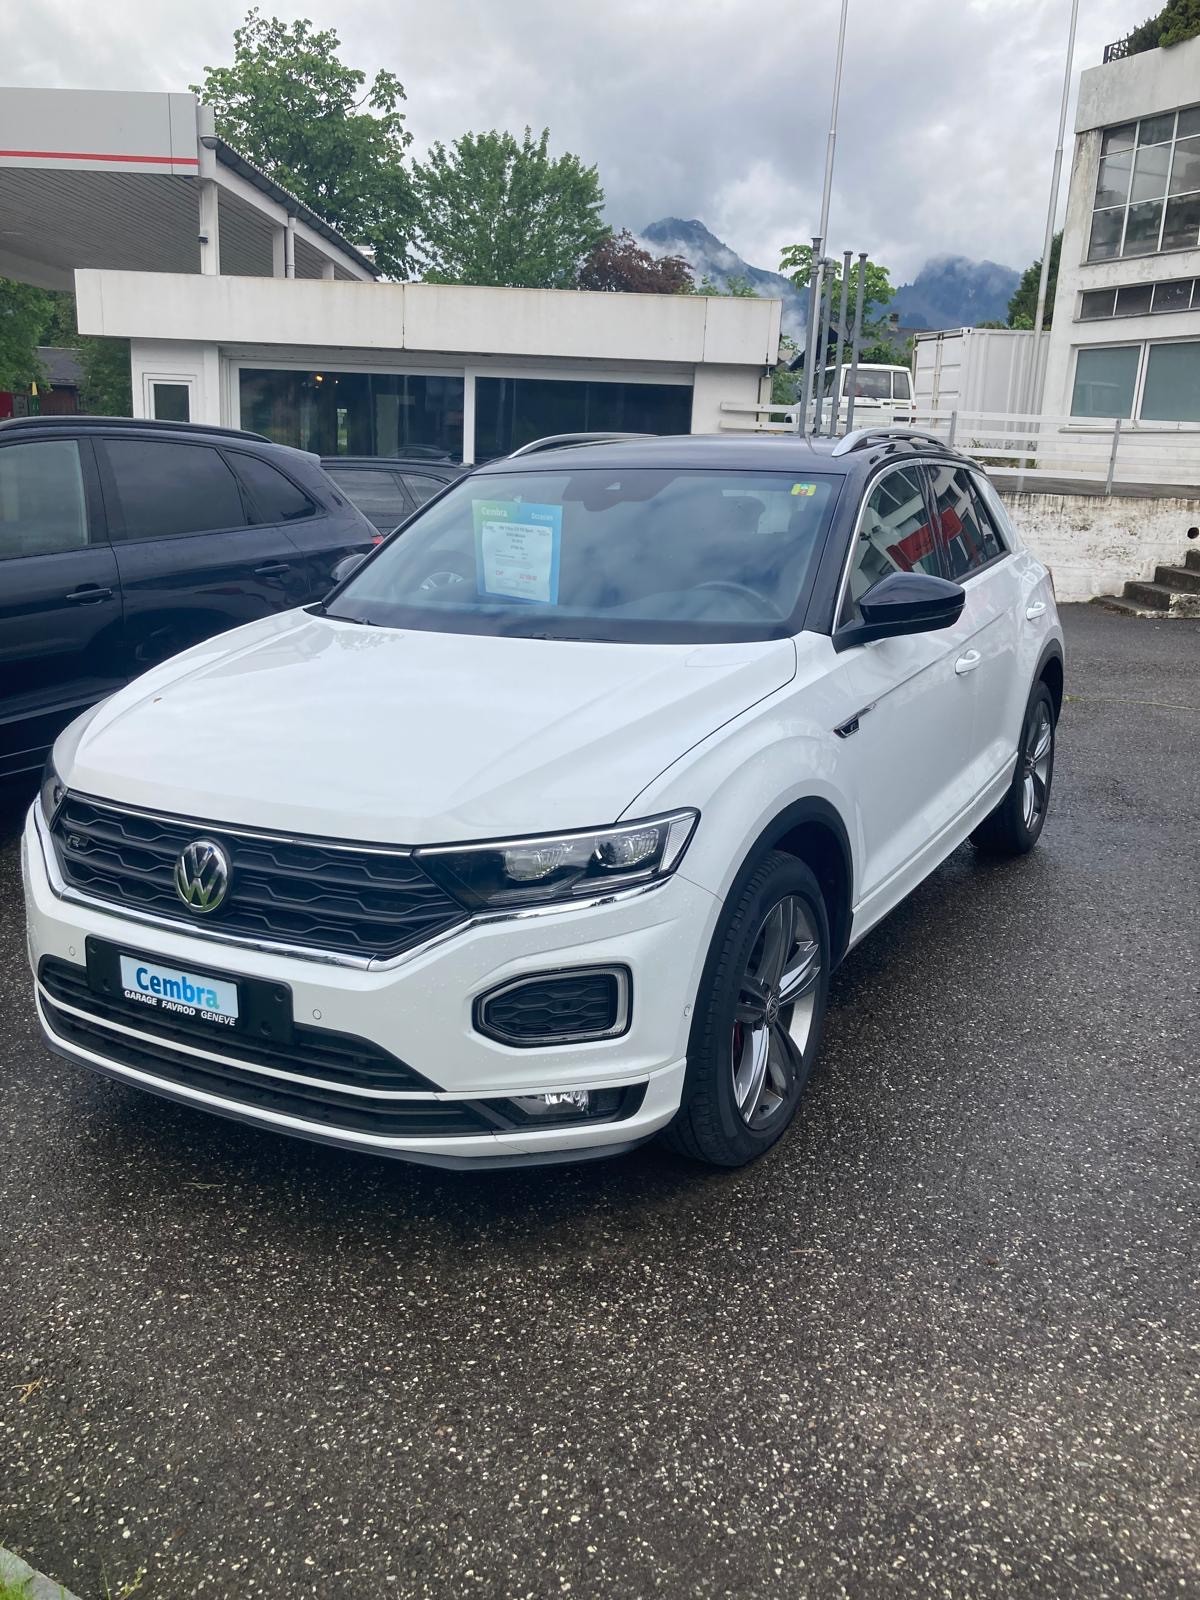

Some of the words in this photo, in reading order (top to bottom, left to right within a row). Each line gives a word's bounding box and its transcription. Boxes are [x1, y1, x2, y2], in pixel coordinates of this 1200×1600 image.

[176, 840, 228, 912] VW
[124, 990, 157, 1005] GARAGE
[162, 1001, 195, 1015] FAVROD
[201, 1012, 235, 1025] GENEVE
[136, 967, 220, 1010] Cembra
